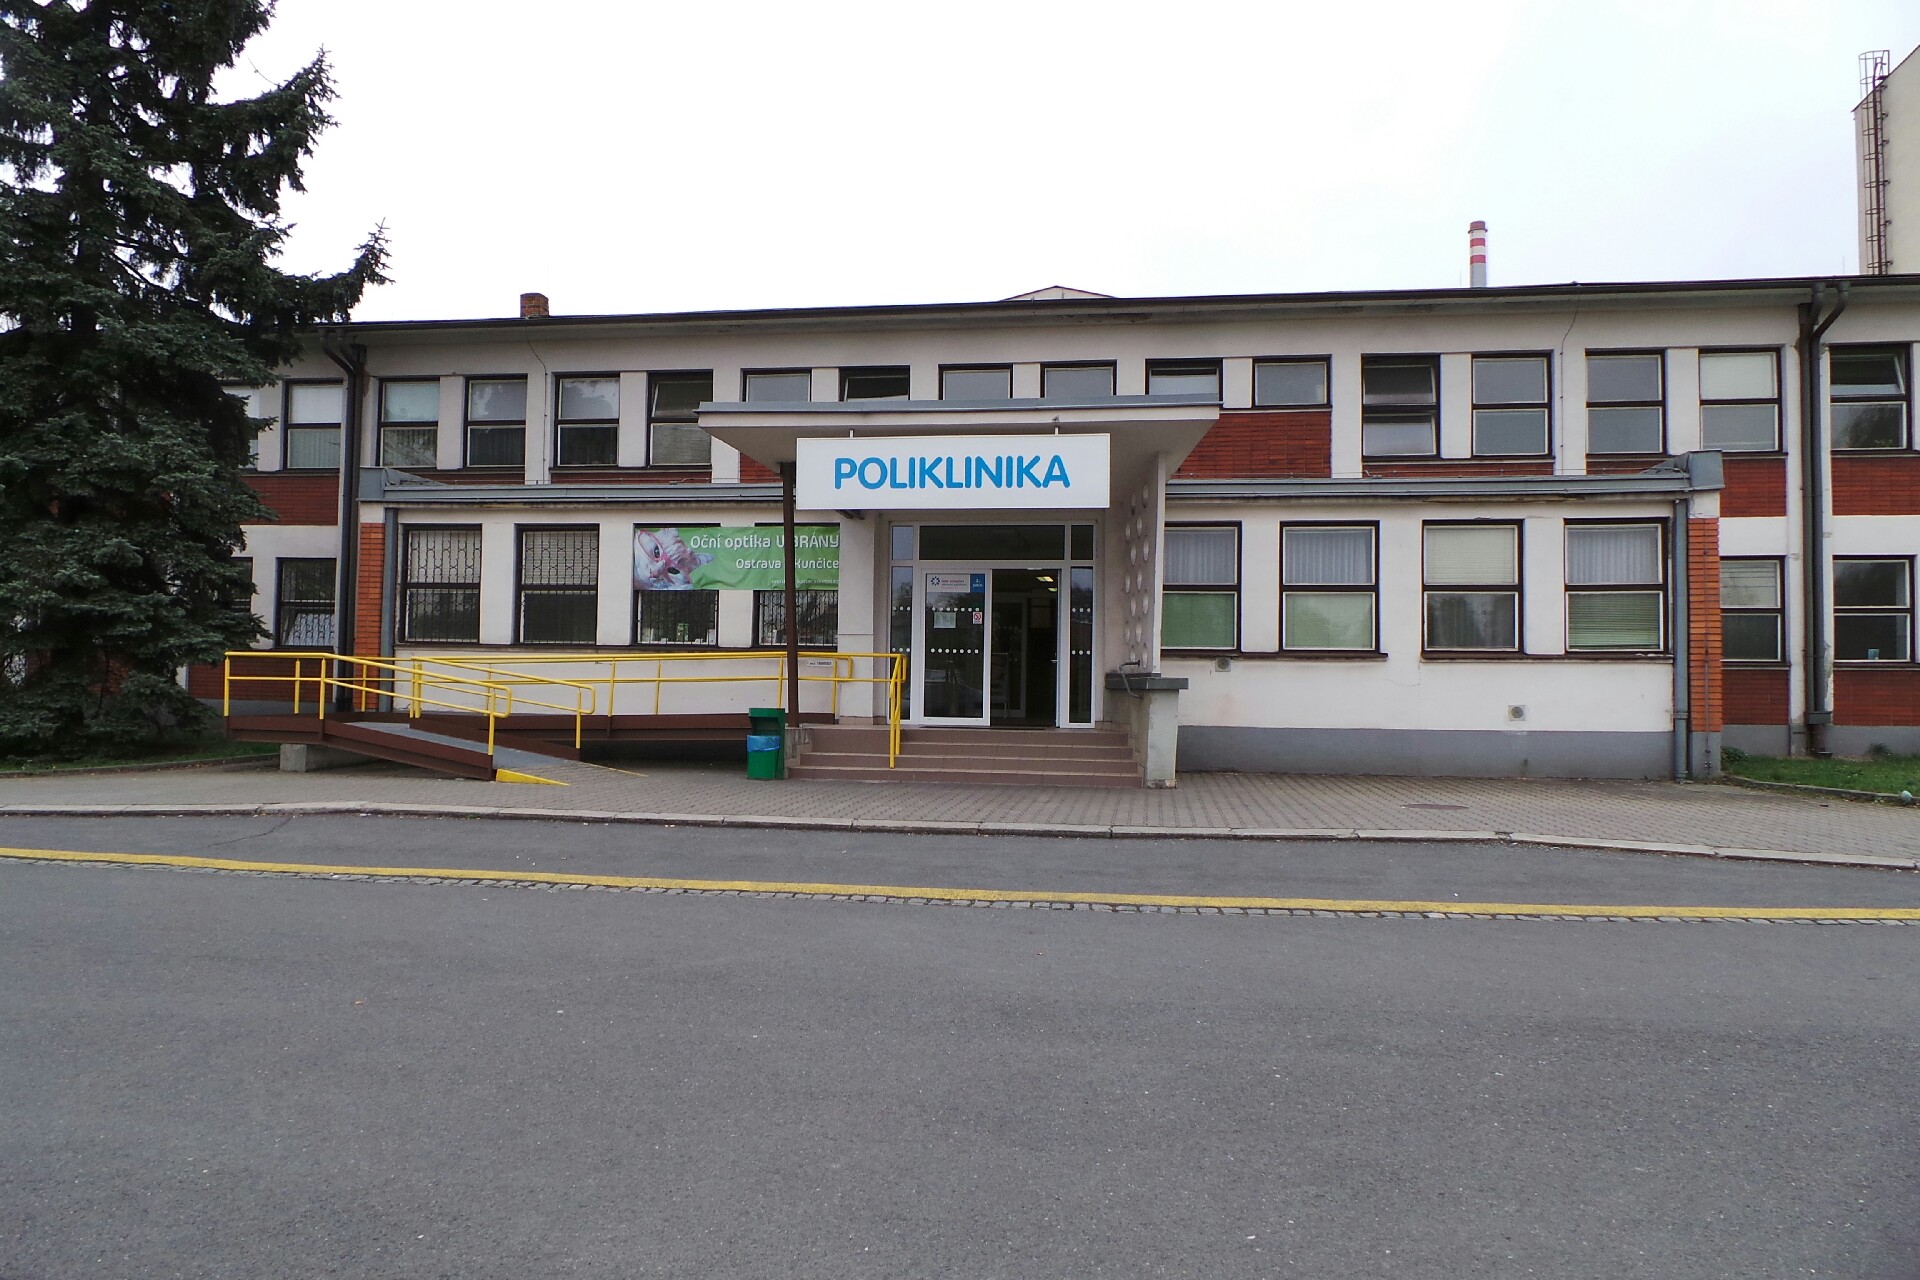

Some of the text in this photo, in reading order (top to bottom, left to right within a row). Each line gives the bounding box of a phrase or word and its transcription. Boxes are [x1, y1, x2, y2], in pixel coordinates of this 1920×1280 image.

[834, 455, 1071, 490] POLIKLINIKA
[690, 533, 721, 549] Oční
[724, 534, 771, 551] optika
[736, 558, 782, 569] Ostrava
